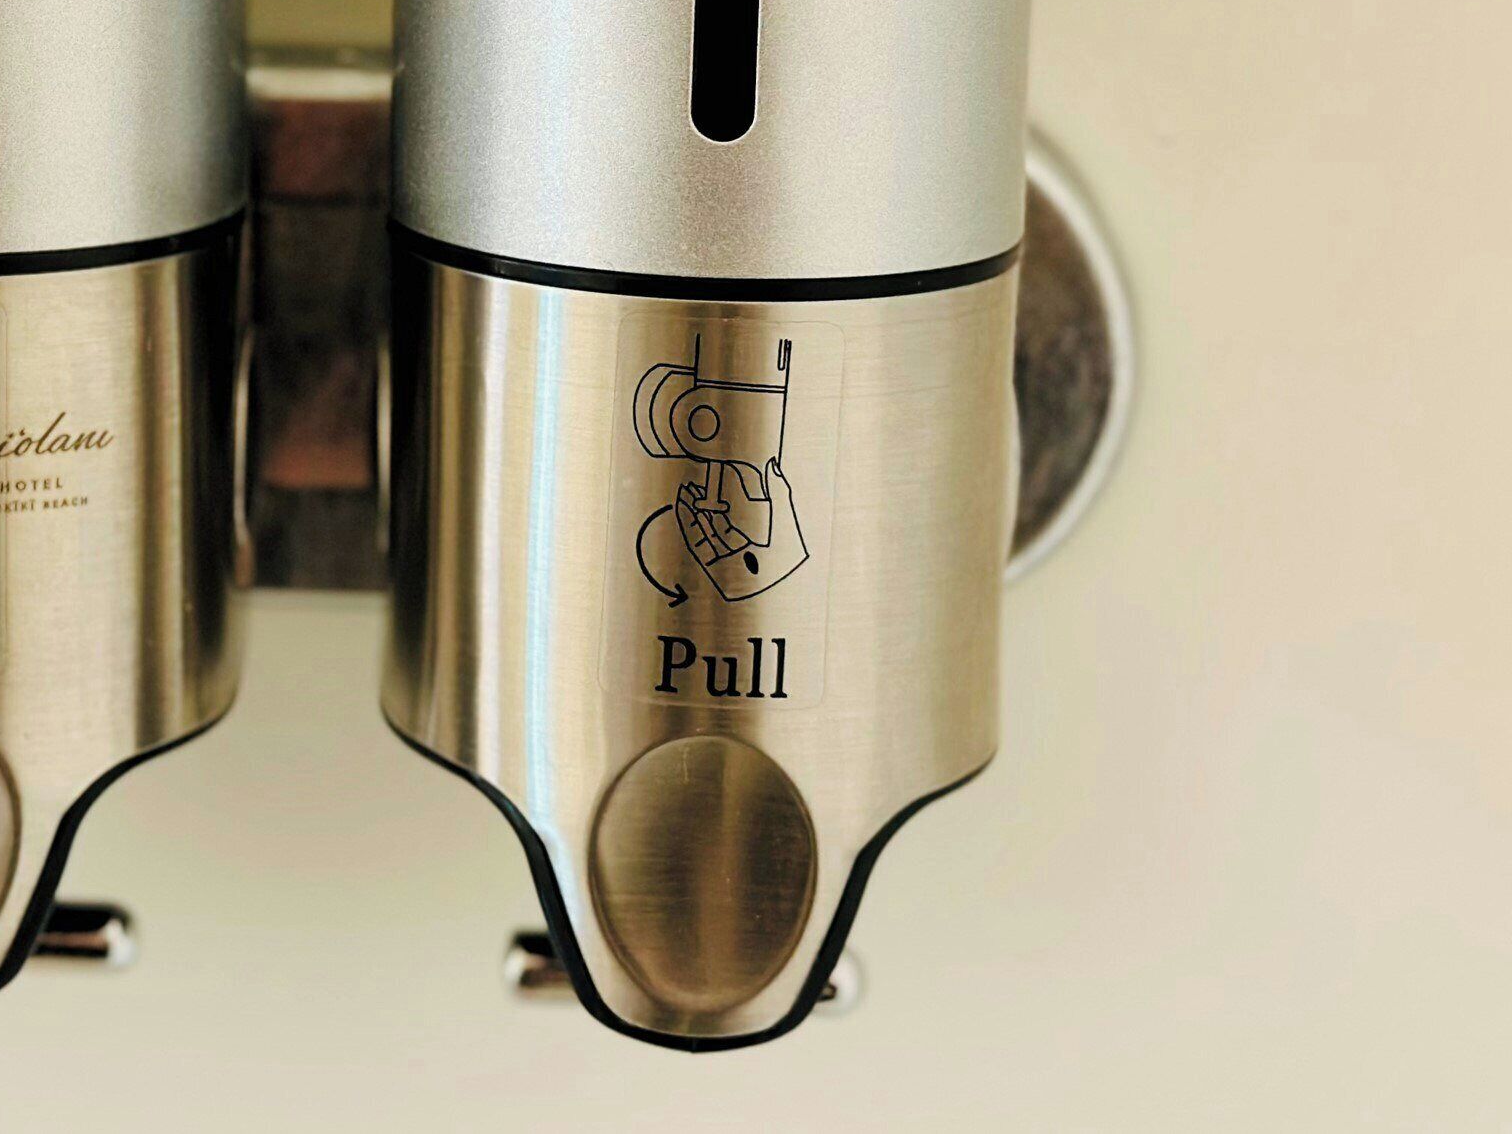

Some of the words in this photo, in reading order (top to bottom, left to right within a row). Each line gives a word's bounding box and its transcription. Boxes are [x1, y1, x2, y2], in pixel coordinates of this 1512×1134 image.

[0, 477, 63, 493] HOTEL
[43, 496, 88, 509] BEACH
[655, 635, 788, 699] Pull
